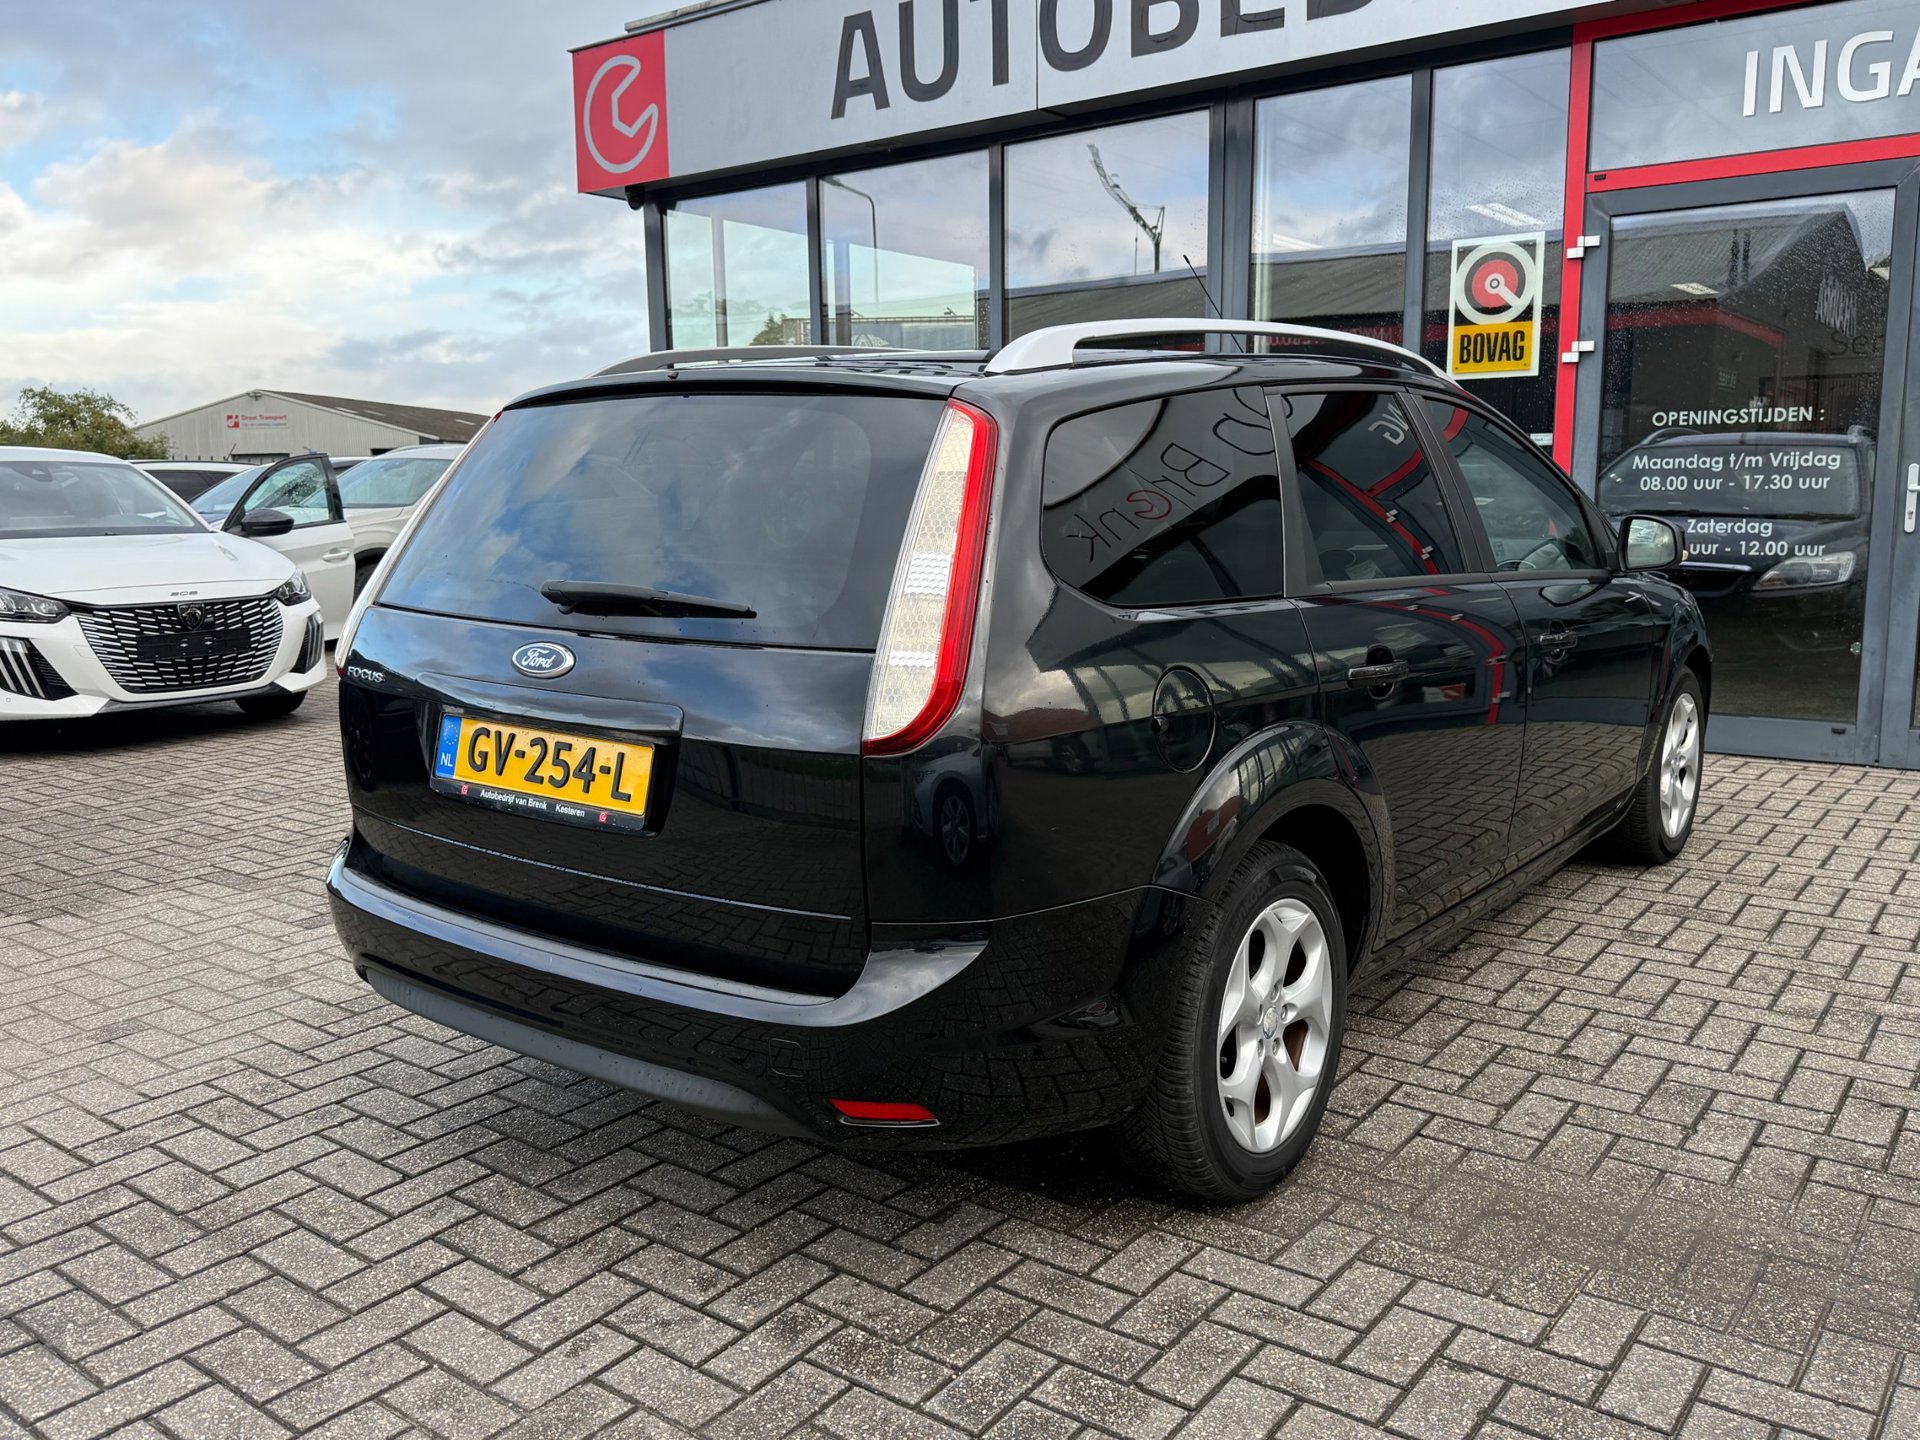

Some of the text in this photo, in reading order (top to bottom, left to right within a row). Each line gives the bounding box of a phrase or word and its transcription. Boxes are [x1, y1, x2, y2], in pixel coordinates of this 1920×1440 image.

[831, 0, 1376, 120] AUTOB
[1458, 330, 1526, 365] BOVAG
[1651, 407, 1813, 427] OPENINGSTIJDEN
[1632, 451, 1841, 471] Maandag t/m Vrijdag
[1639, 476, 1688, 491] 08.00
[1693, 478, 1723, 490] uur
[1743, 475, 1793, 490] 17.30
[1798, 476, 1831, 489] uur
[1687, 519, 1773, 537] Zaterdag
[1689, 542, 1719, 555] uur
[1739, 541, 1788, 556] 12.00
[1794, 543, 1826, 557] uur
[521, 649, 555, 669] Ford
[346, 666, 385, 683] FOCUS
[440, 752, 454, 768] NL
[467, 727, 632, 802] GV-254-L
[480, 789, 585, 817] Autobedrijf van Brenk Kesteren
